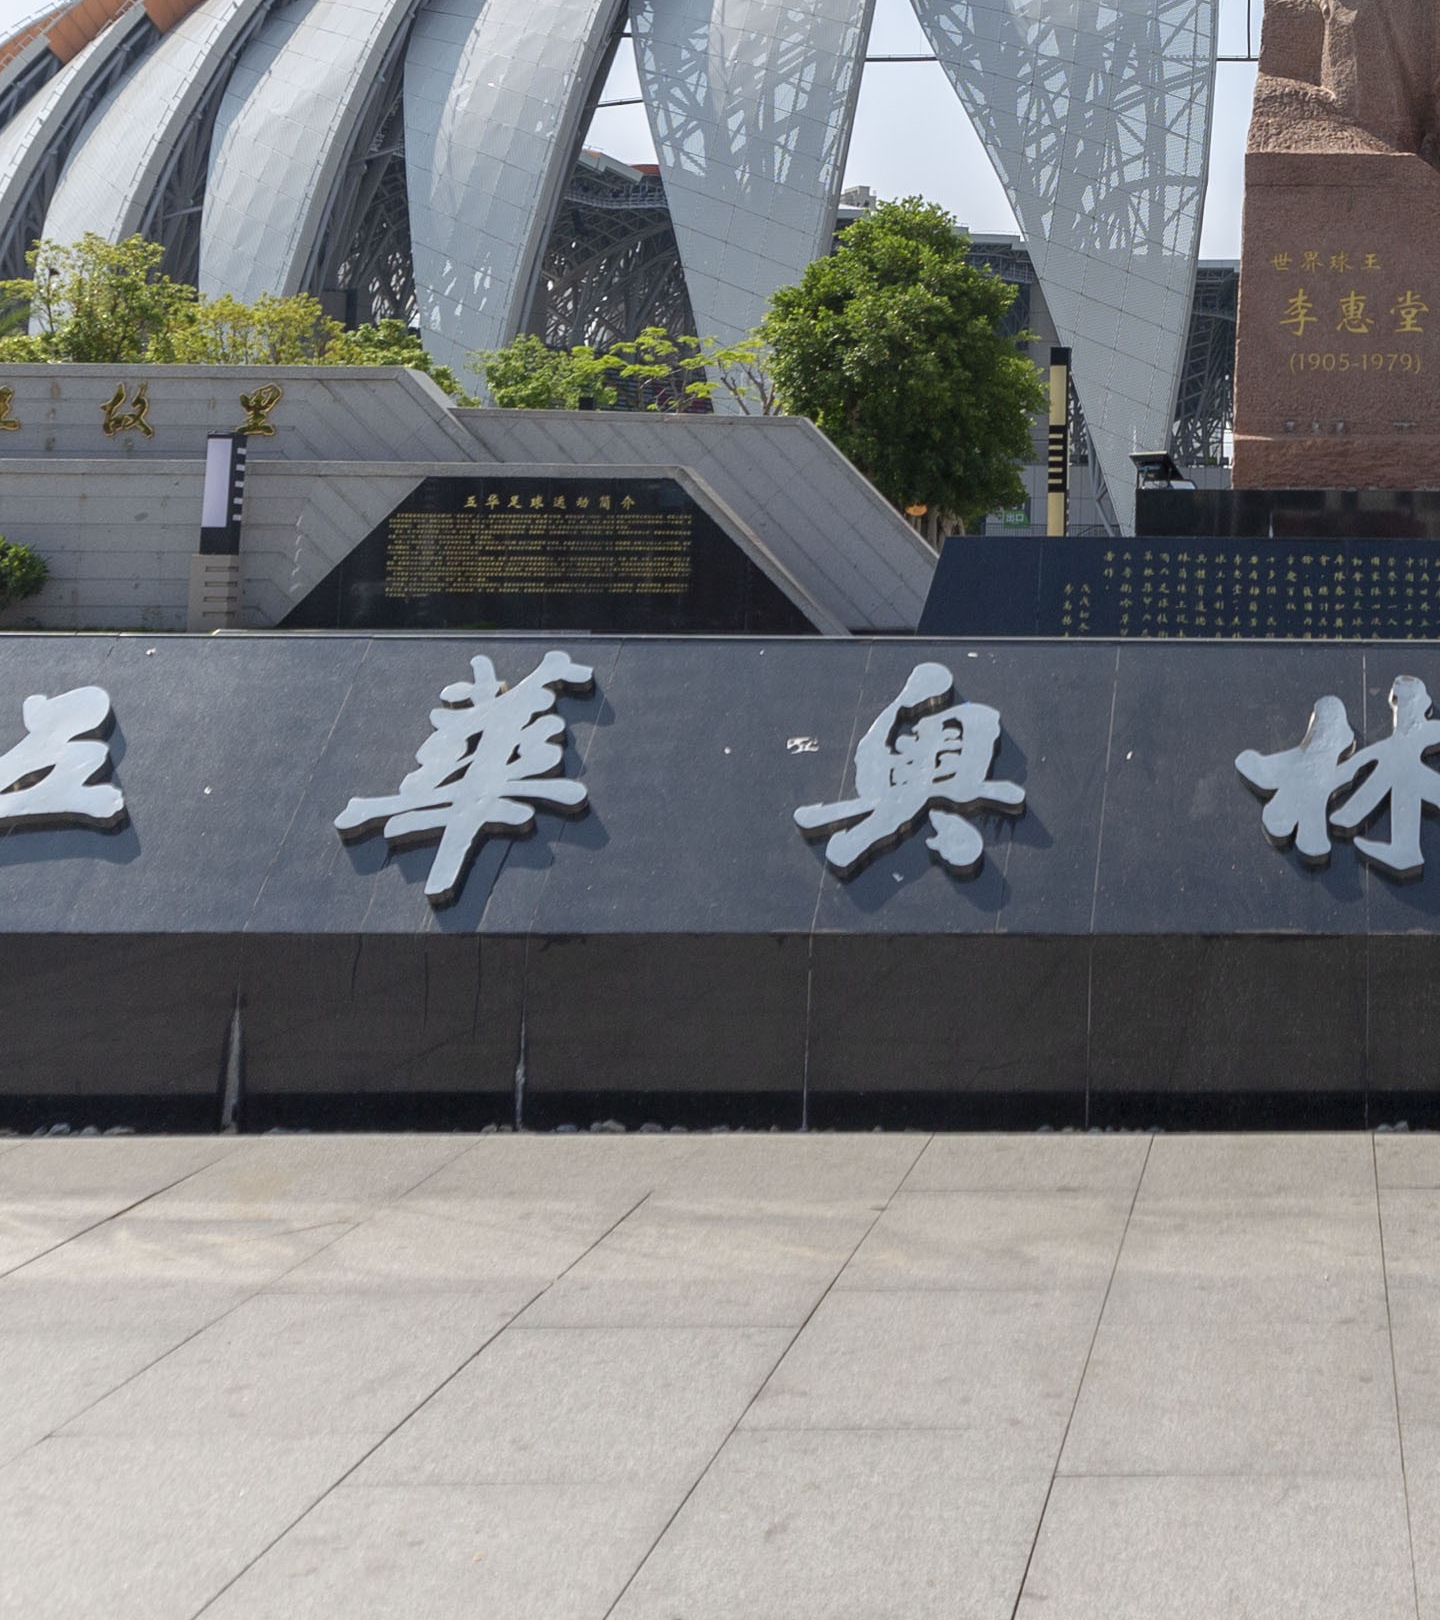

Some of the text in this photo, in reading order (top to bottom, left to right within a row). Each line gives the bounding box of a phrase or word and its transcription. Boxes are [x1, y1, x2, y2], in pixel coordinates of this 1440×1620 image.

[1269, 251, 1382, 272] 世界球王
[1279, 288, 1430, 337] 李惠堂
[1289, 352, 1422, 374] (1905-1979)
[463, 493, 636, 510] 五华足球运动简介
